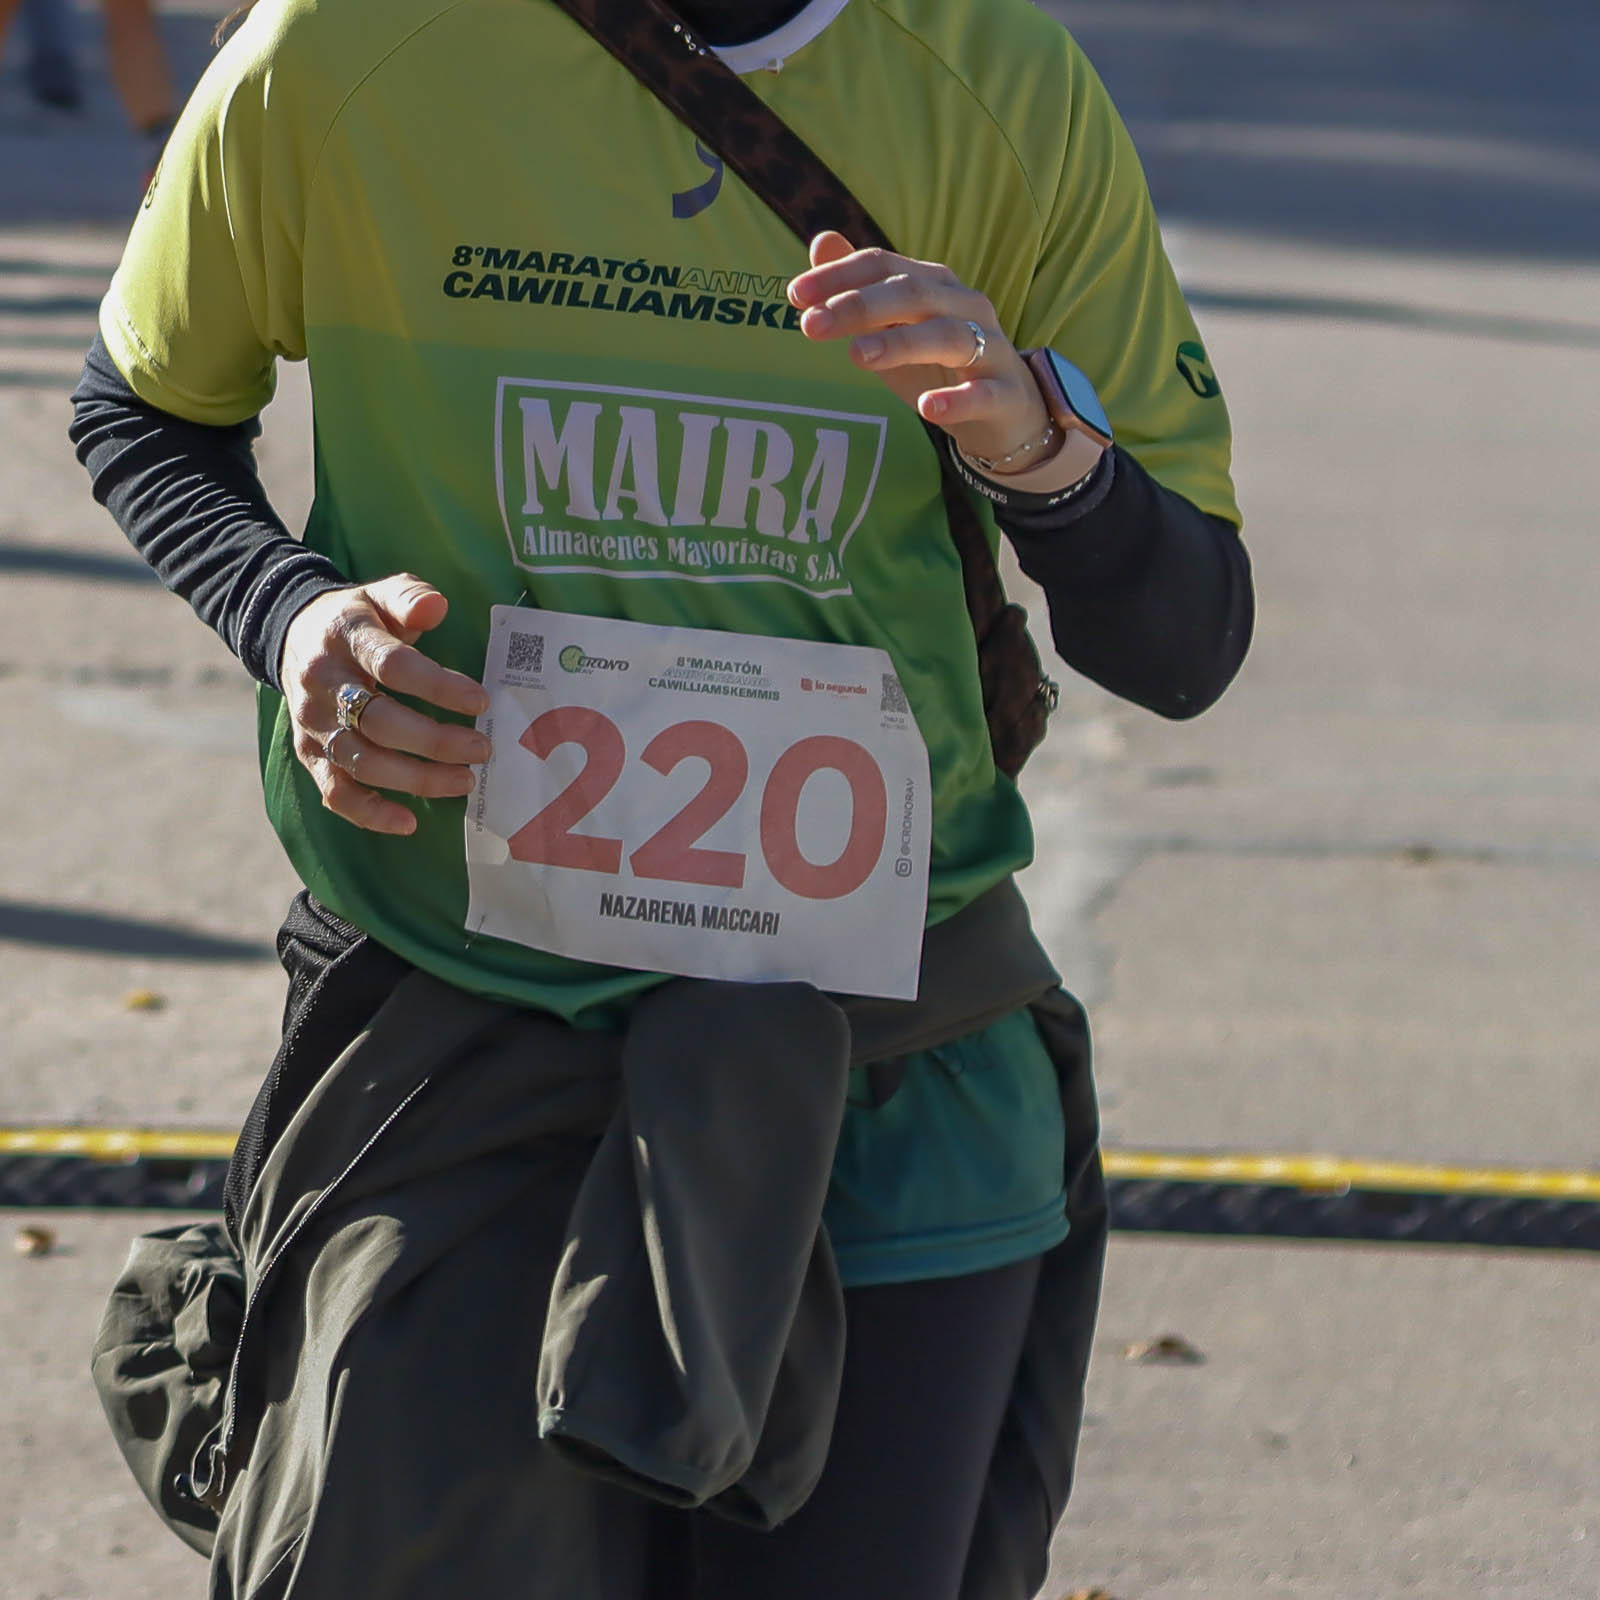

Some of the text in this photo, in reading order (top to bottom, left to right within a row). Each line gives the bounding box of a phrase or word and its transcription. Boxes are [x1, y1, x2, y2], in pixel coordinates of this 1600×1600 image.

[518, 397, 850, 545] MAIRA
[522, 525, 841, 582] Almacenes Mayoristas S.A.
[649, 677, 780, 702] CAWILLIAMSKEMMIS
[507, 705, 888, 901] 220
[599, 892, 780, 936] NAZARENA MACCARI
